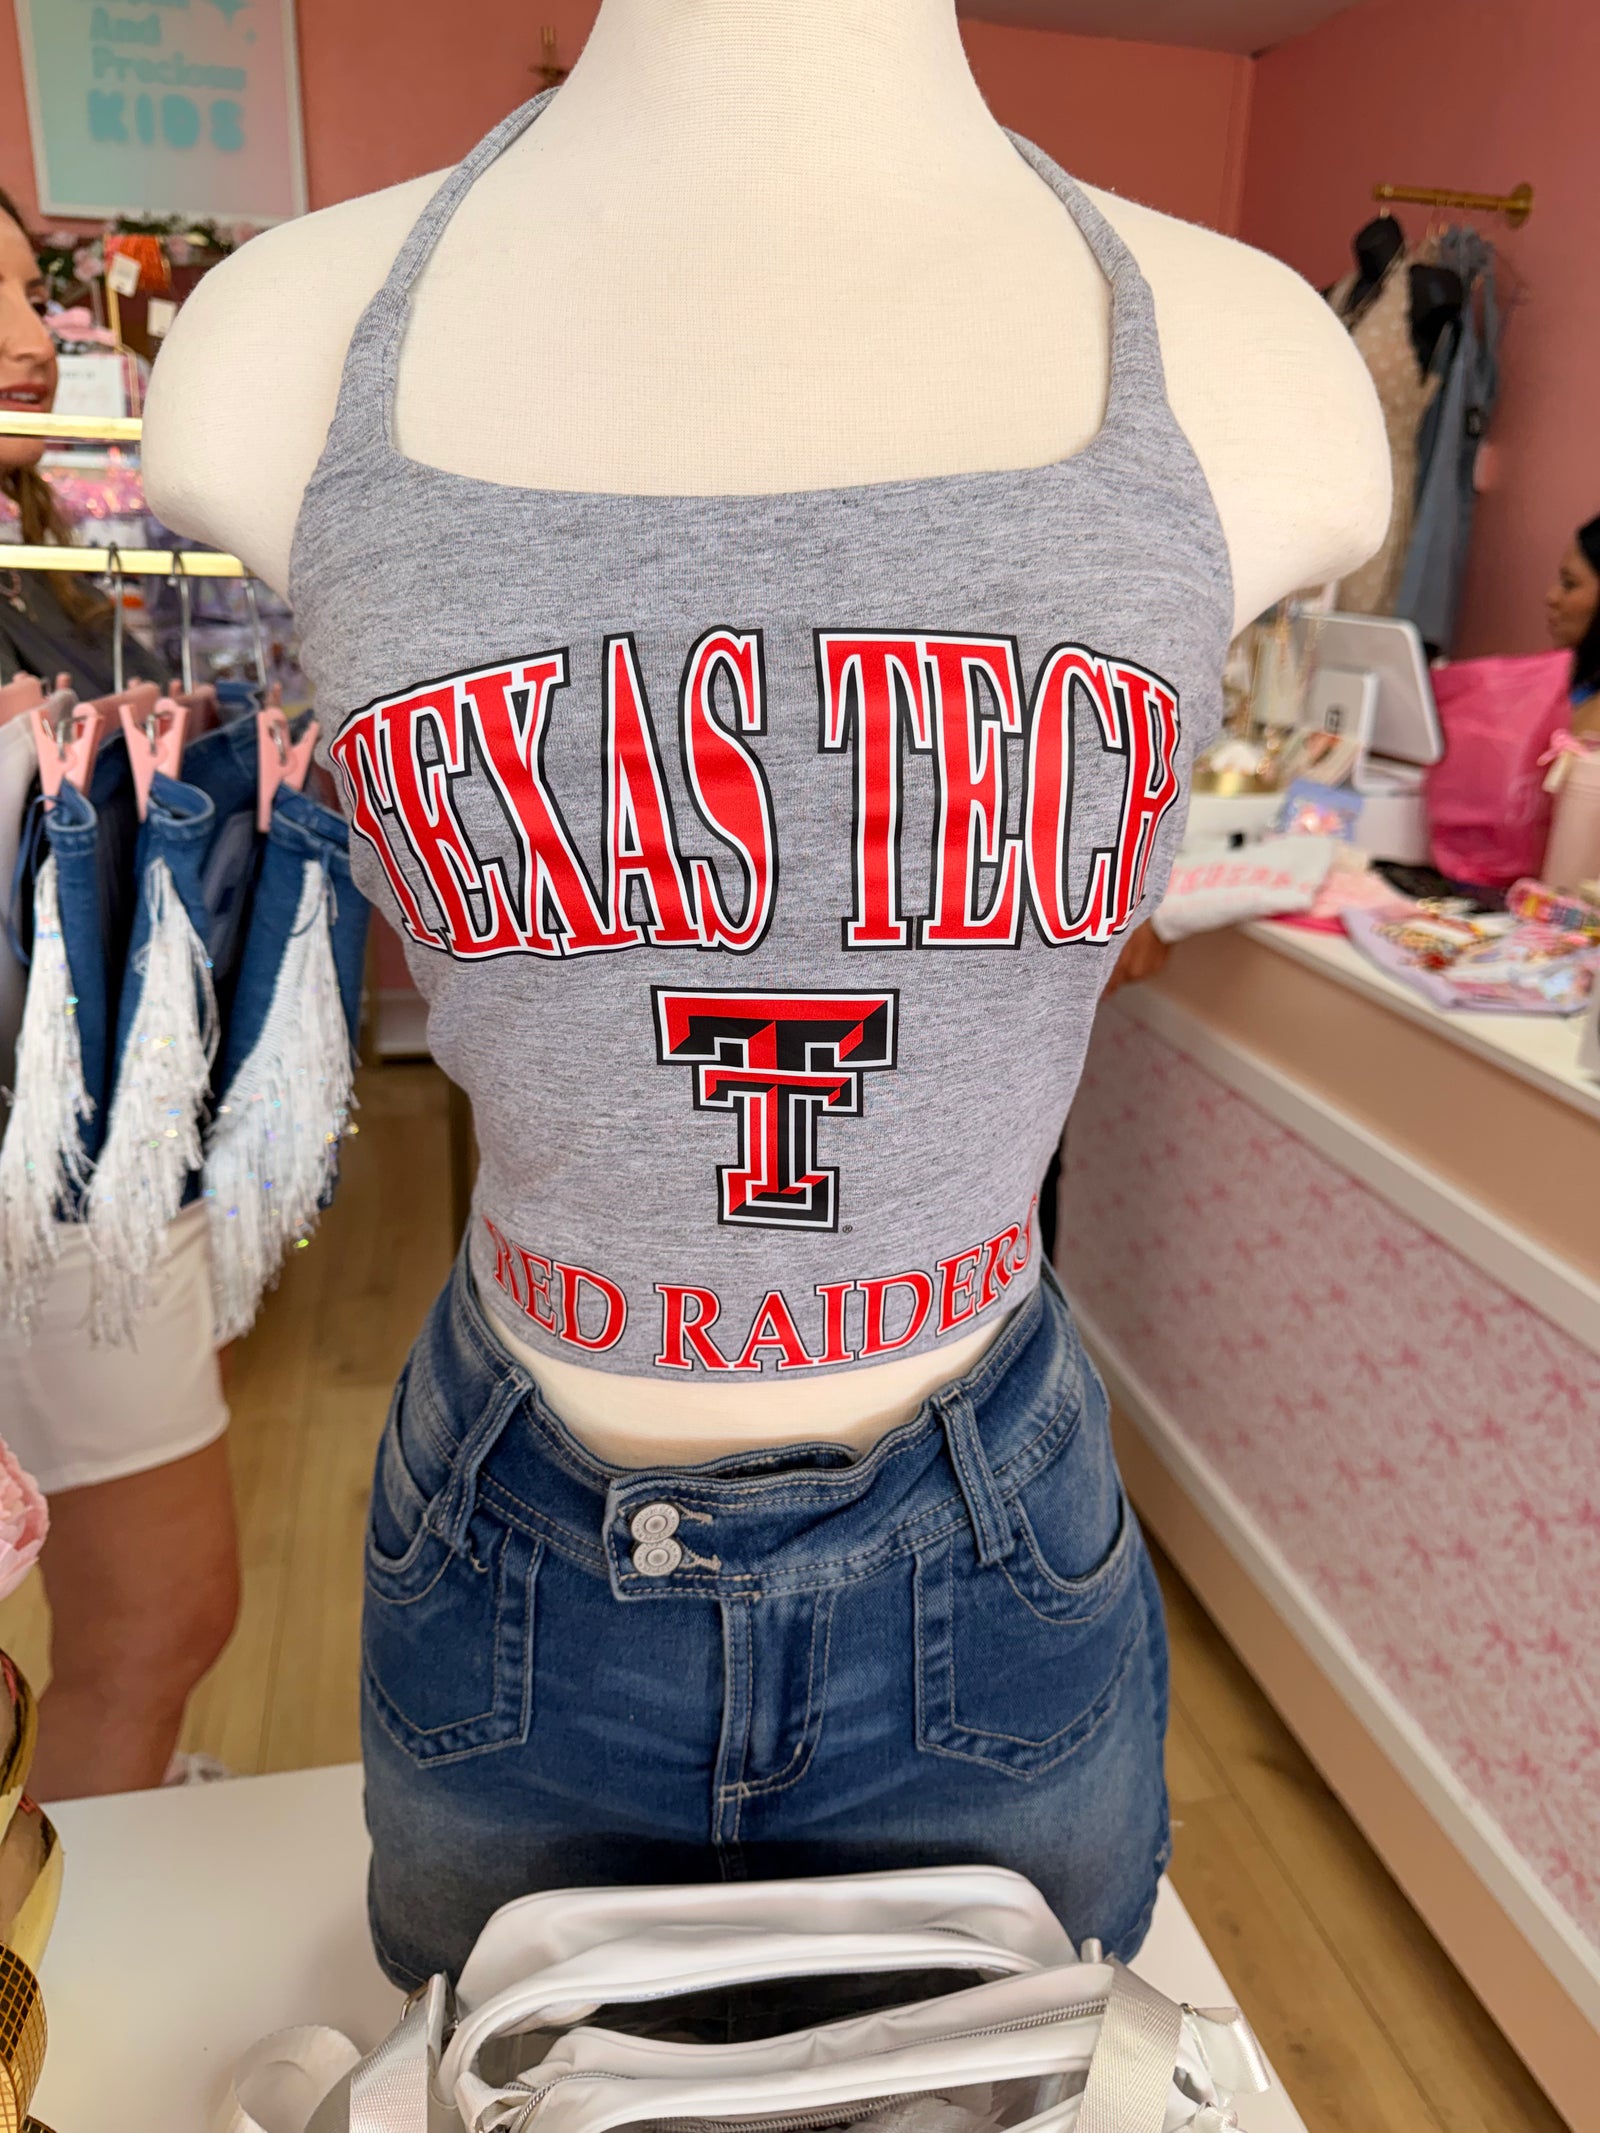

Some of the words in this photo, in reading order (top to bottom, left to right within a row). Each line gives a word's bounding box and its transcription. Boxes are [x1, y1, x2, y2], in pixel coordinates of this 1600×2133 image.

[87, 88, 245, 154] KIDS
[330, 625, 779, 962] TEXAS
[813, 628, 1181, 951] TECH
[482, 1215, 628, 1353] RED
[653, 1193, 1038, 1373] RAIDERS
